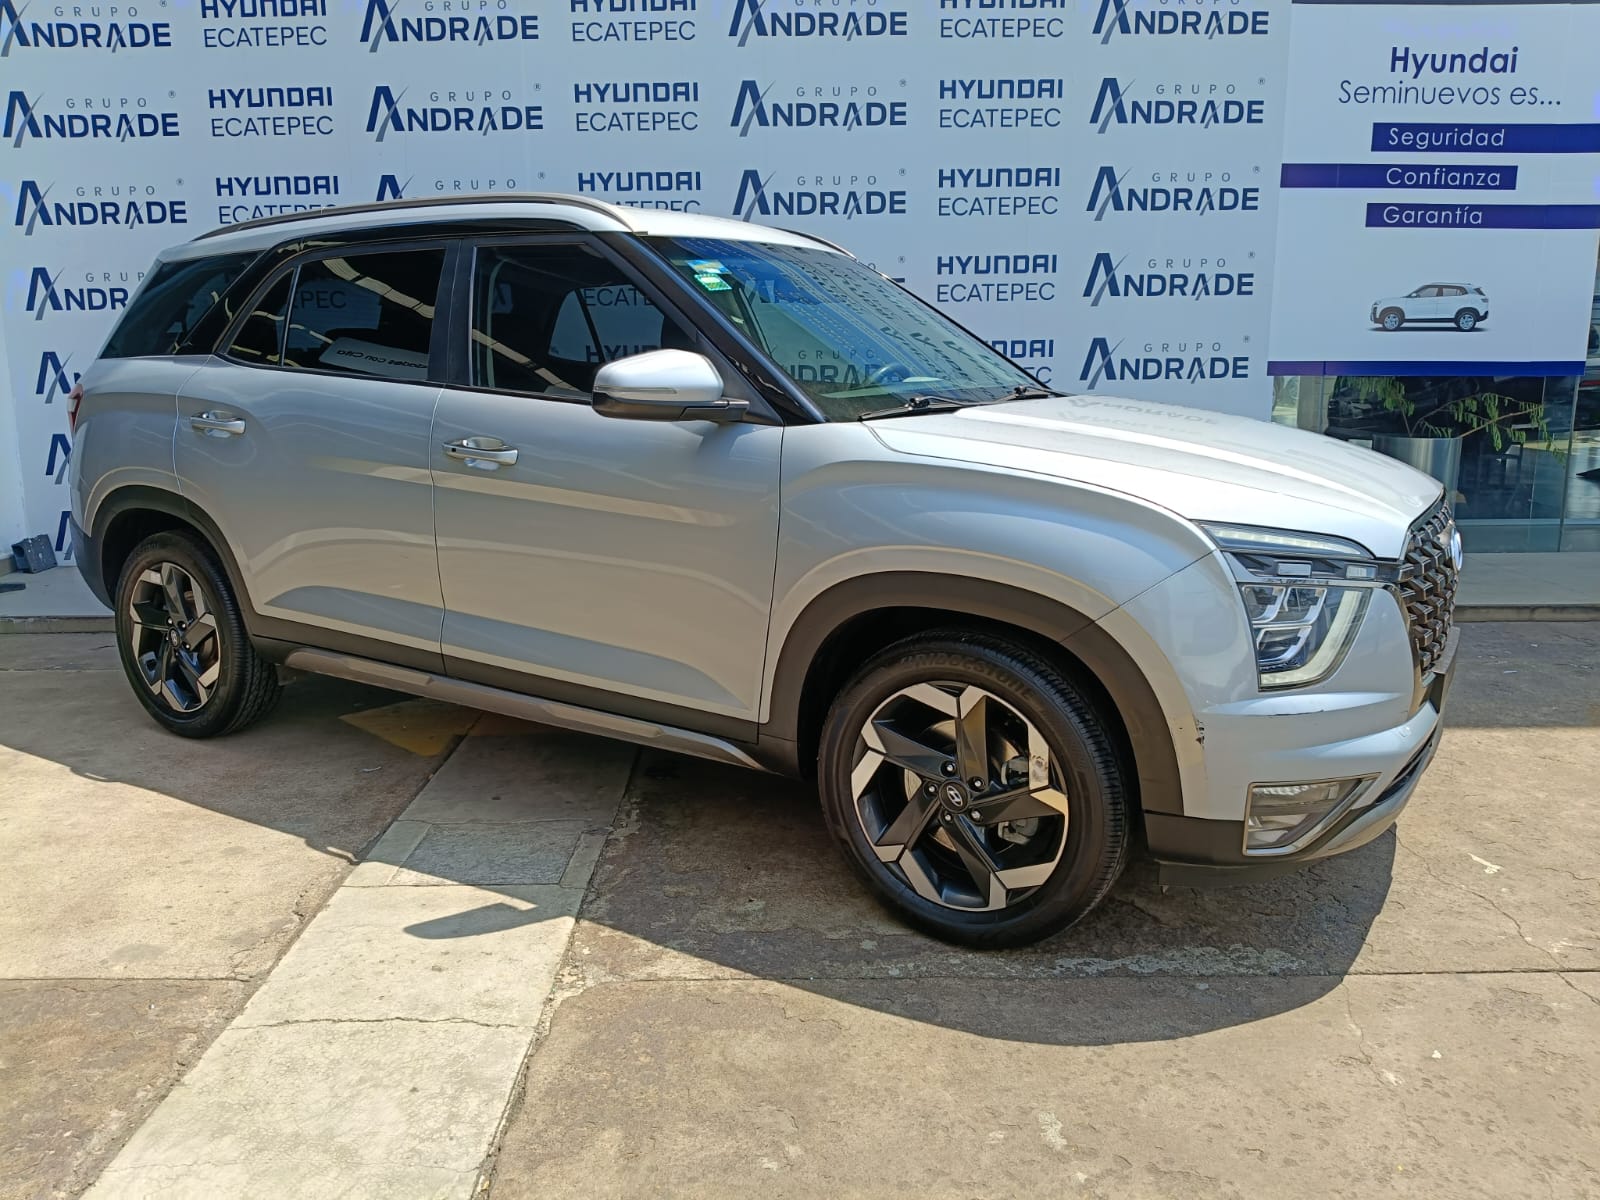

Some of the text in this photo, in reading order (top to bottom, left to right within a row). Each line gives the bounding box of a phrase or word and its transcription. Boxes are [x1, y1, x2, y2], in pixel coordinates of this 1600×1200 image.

[54, 6, 137, 17] GRUPO
[201, 0, 326, 18] HYUNDAI
[425, 0, 506, 11] GRUPO
[0, 0, 172, 57] ANDRADE
[360, 0, 539, 53] ANDRADE
[572, 21, 695, 42] ECATEPEC
[728, 0, 907, 47] ANDRADE
[940, 18, 1063, 38] ECATEPEC
[1092, 0, 1269, 45] ANDRADE
[204, 26, 327, 48] ECATEPEC
[1390, 46, 1519, 79] Hyundai
[208, 86, 333, 109] HYUNDAI
[430, 90, 511, 102] GRUPO
[574, 82, 698, 103] HYUNDAI
[797, 86, 877, 97] GRUPO
[940, 79, 1063, 99] HYUNDAI
[1156, 84, 1235, 95] GRUPO
[1338, 80, 1560, 105] Seminuevos es...
[66, 98, 146, 108] GRUPO
[366, 83, 543, 142] ANDRADE
[730, 79, 907, 137] ANDRADE
[1089, 78, 1265, 134] ANDRADE
[3, 90, 180, 148] ANDRADE
[211, 115, 334, 137] ECATEPEC
[576, 111, 698, 132] ECATEPEC
[940, 108, 1061, 128] ECATEPEC
[1388, 127, 1505, 150] Seguridad
[216, 176, 339, 196] HYUNDAI
[435, 179, 516, 190] GRUPO
[578, 171, 701, 192] HYUNDAI
[797, 176, 876, 186] GRUPO
[938, 167, 1060, 188] HYUNDAI
[1152, 172, 1230, 182] GRUPO
[1386, 167, 1501, 187] Confianza
[76, 186, 155, 196] GRUPO
[733, 170, 907, 222] ANDRADE
[1085, 166, 1260, 221] ANDRADE
[15, 178, 187, 236] ANDRADE
[939, 196, 1058, 216] ECATEPEC
[1383, 206, 1483, 225] Garantía
[937, 254, 1057, 275] HYUNDAI
[1148, 258, 1225, 268] GRUPO
[86, 271, 146, 282] GRUP
[1082, 252, 1255, 307] ANDRADE
[26, 267, 129, 321] ANDR
[936, 282, 1055, 303] ECATEPEC
[1144, 342, 1221, 352] GRUPO
[1079, 336, 1249, 390] ANDRADE
